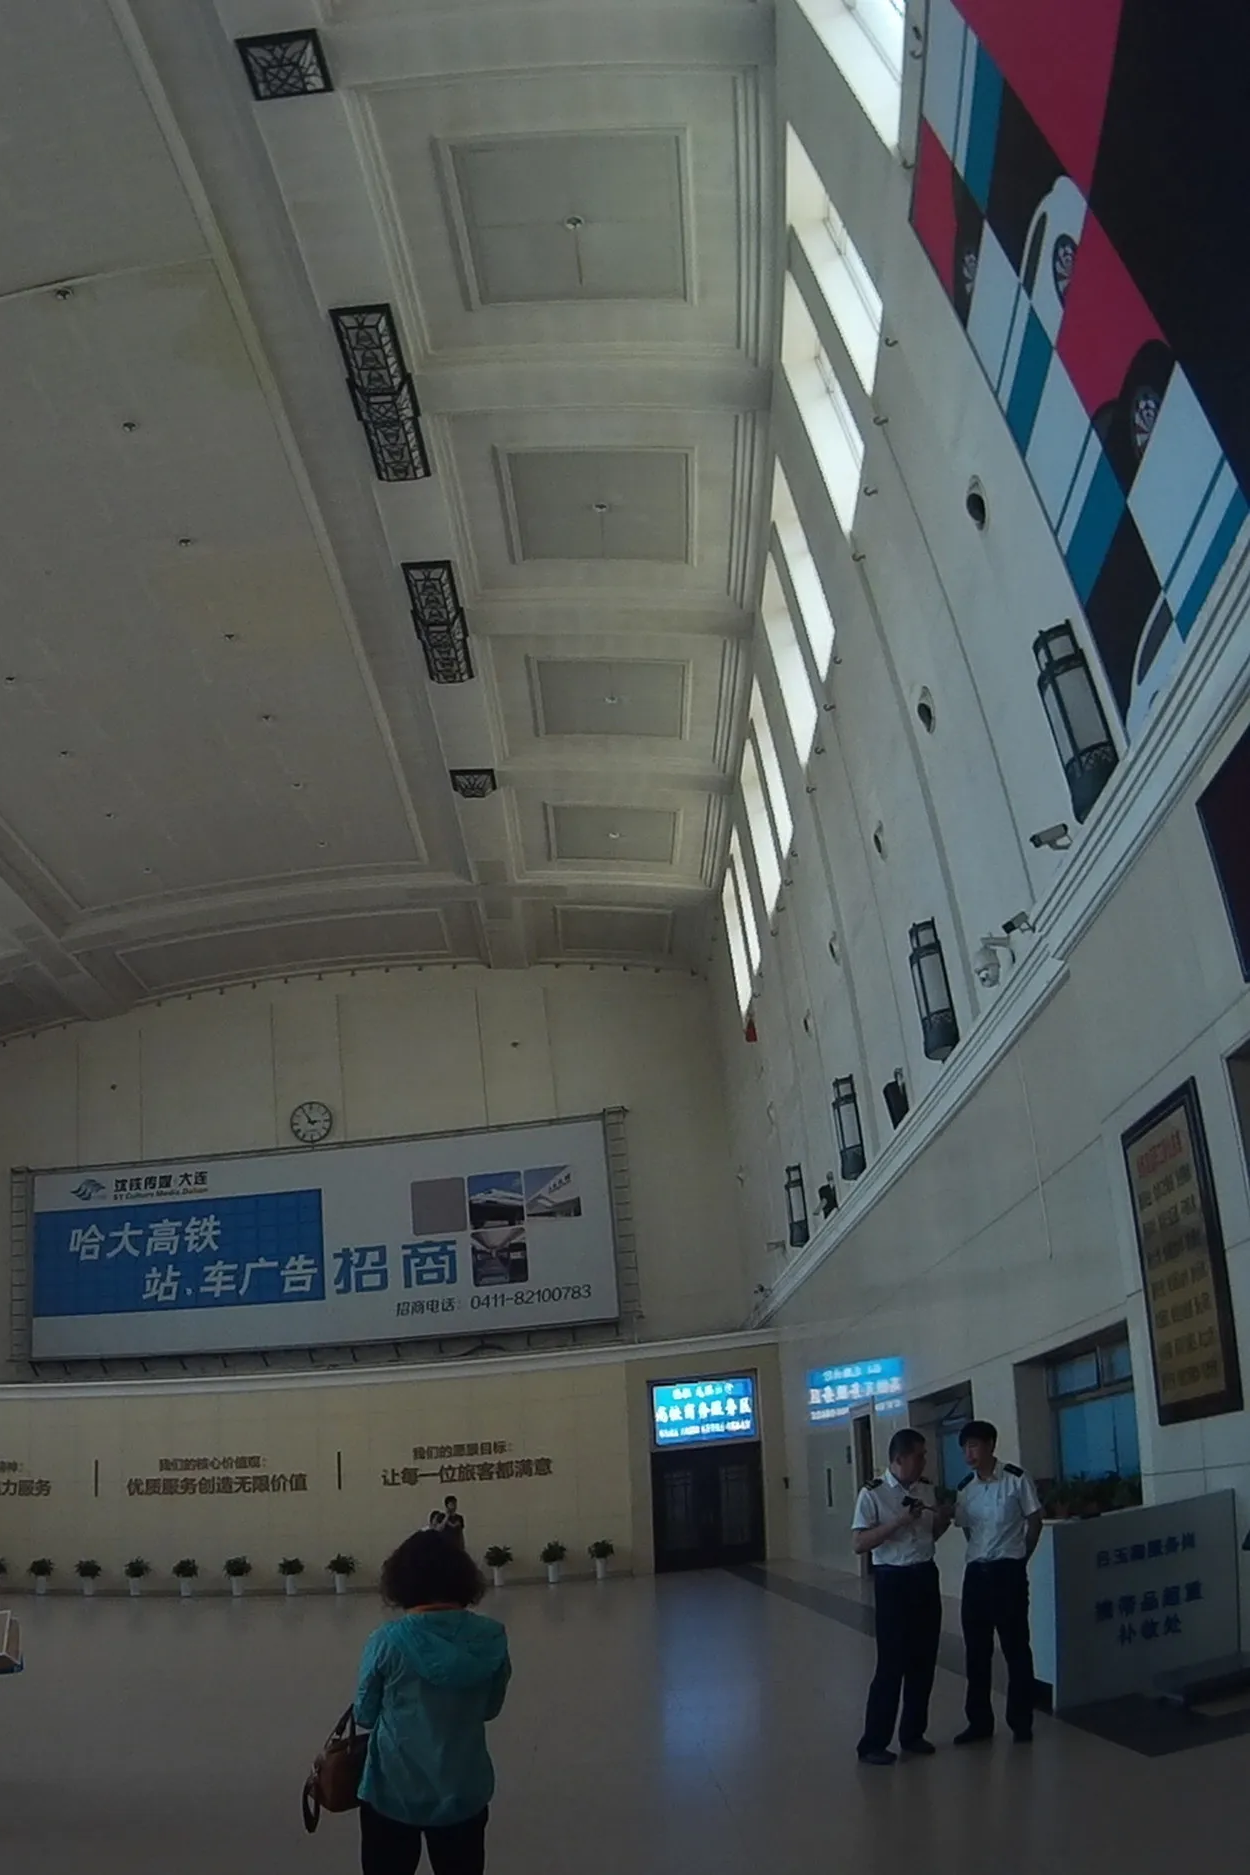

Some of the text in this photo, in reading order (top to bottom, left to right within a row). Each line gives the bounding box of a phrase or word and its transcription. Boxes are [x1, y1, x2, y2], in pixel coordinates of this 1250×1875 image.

[178, 1171, 208, 1187] 大连
[68, 1214, 222, 1261] 哈大高铁
[142, 1254, 319, 1302] 站、车广告
[333, 1239, 458, 1294] 招商
[470, 1284, 592, 1310] 0411-82100783
[125, 1472, 308, 1496] 优质服务创造无限价值
[380, 1456, 553, 1487] 让每一位旅客都满意
